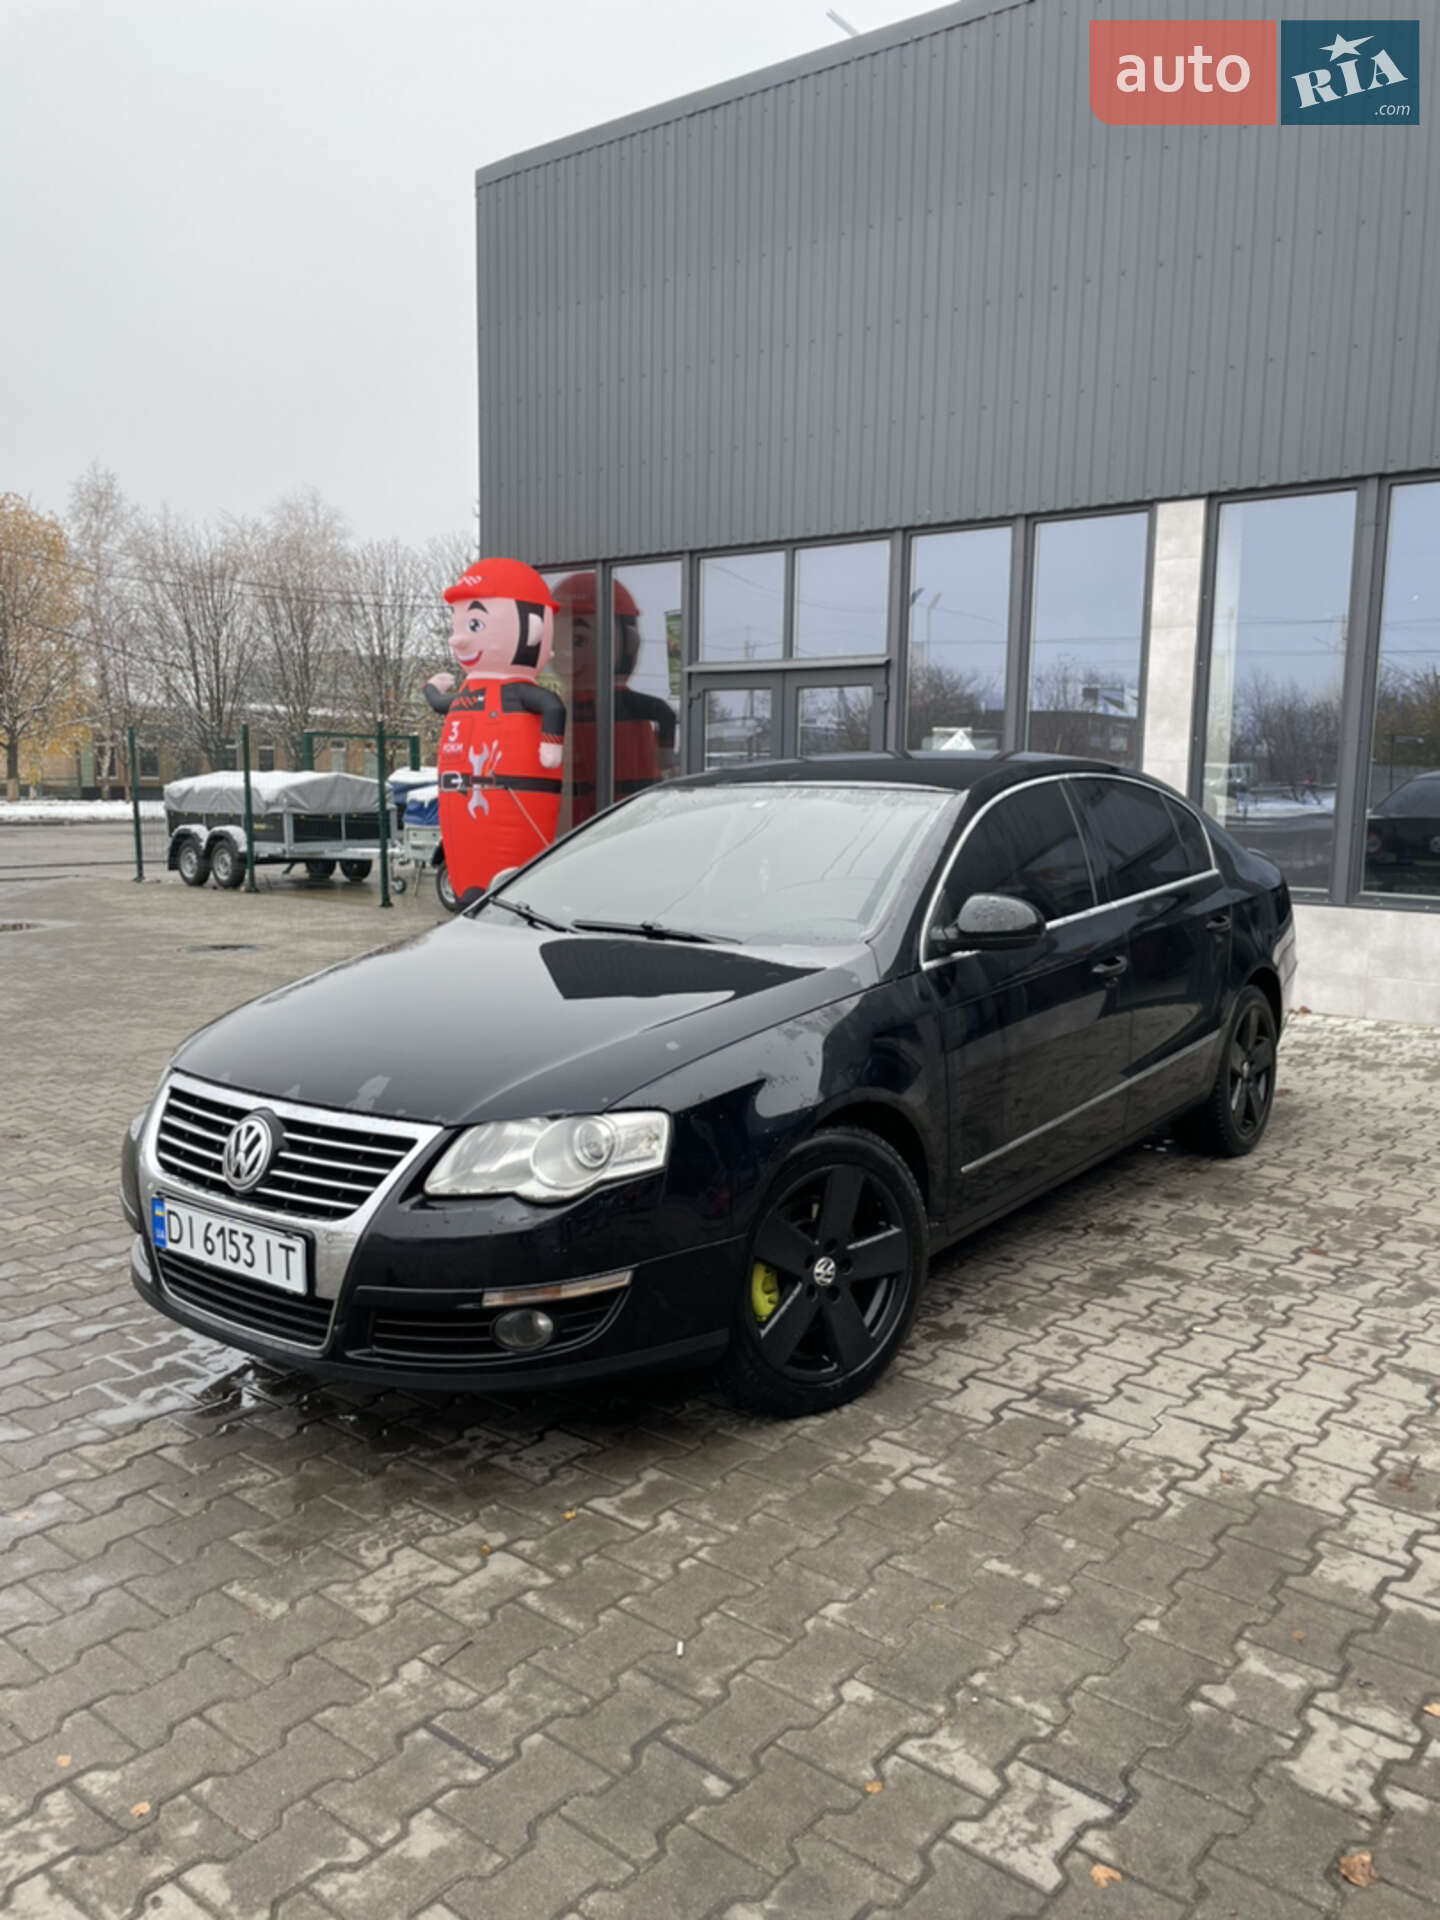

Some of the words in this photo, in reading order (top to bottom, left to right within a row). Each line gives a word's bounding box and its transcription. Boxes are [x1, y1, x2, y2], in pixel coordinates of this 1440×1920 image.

[449, 721, 460, 742] 3
[167, 1210, 194, 1249] DI
[203, 1222, 255, 1269] 6153
[266, 1239, 296, 1281] IT
